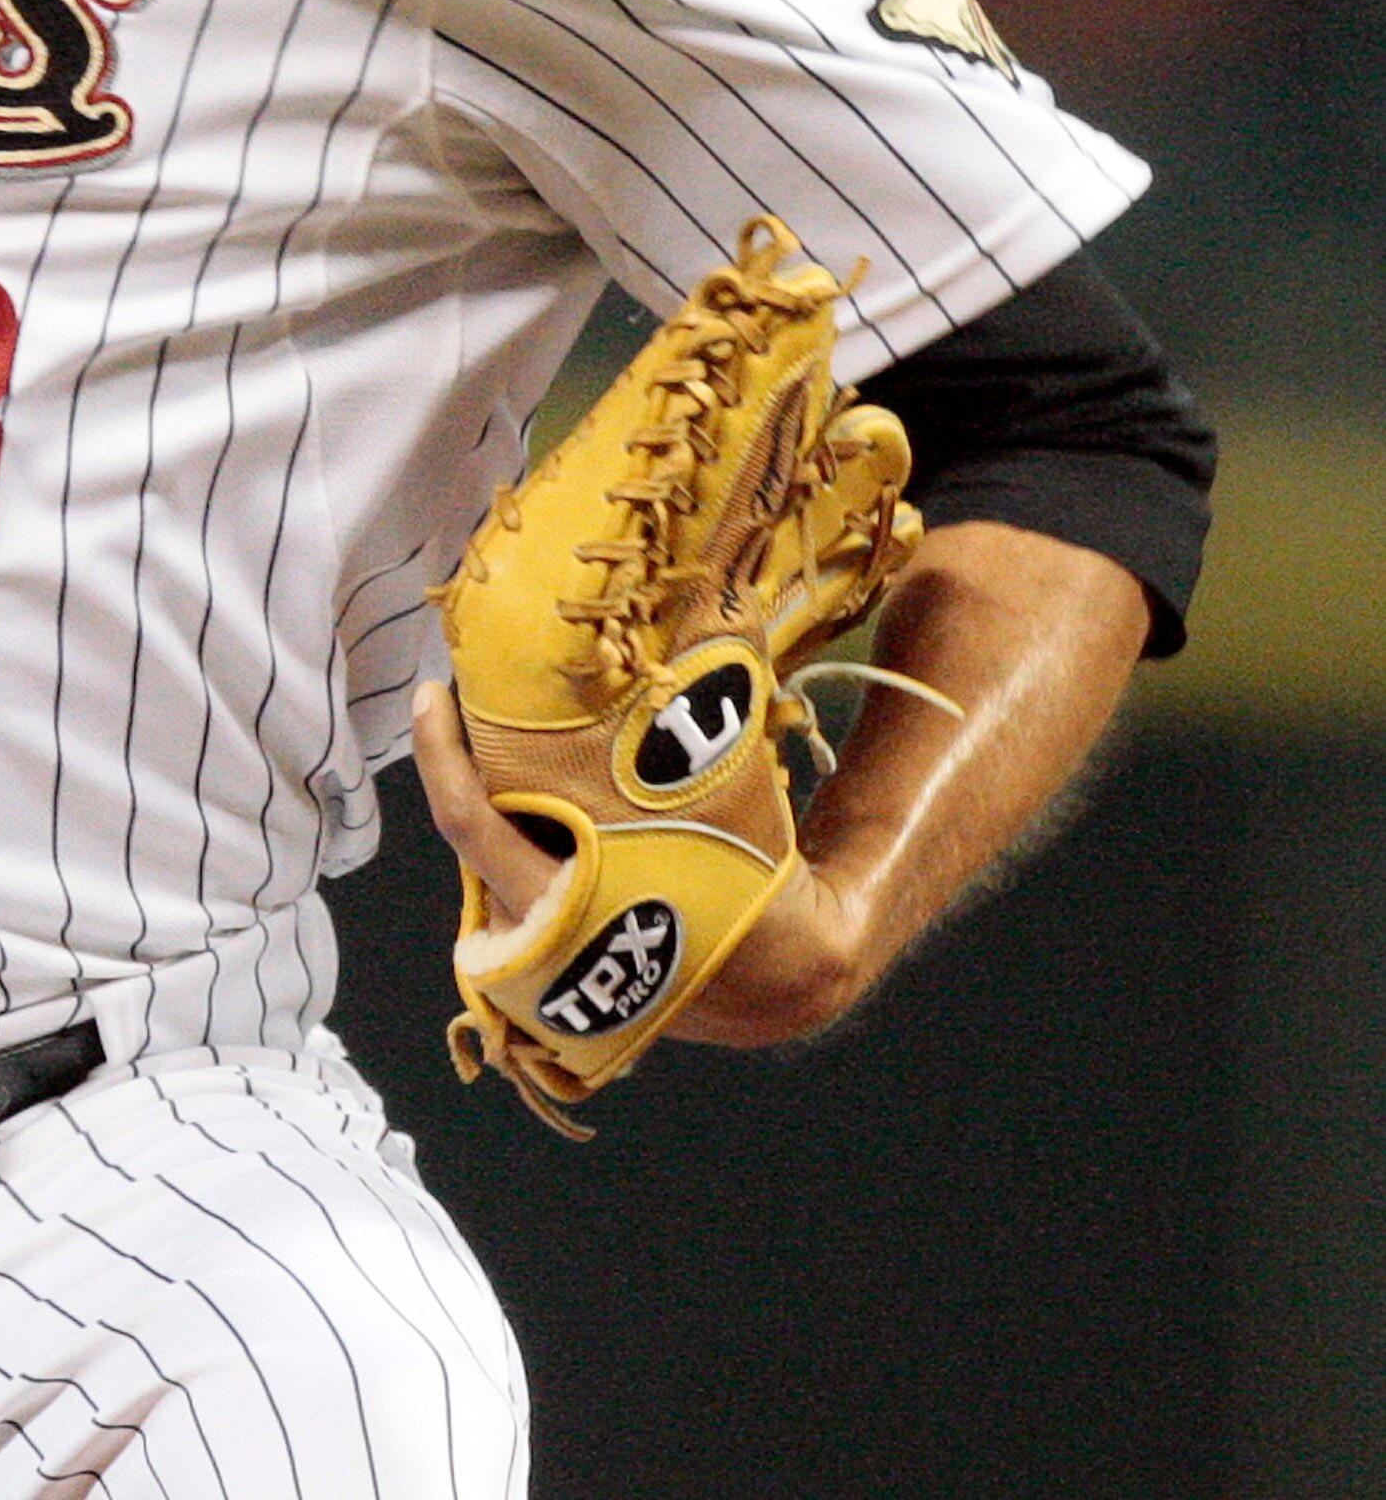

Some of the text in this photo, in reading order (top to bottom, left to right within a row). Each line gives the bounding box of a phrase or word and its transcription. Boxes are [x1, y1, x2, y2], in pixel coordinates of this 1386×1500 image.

[655, 695, 742, 774] L
[540, 909, 668, 1032] TPX
[615, 959, 662, 1019] PRO
